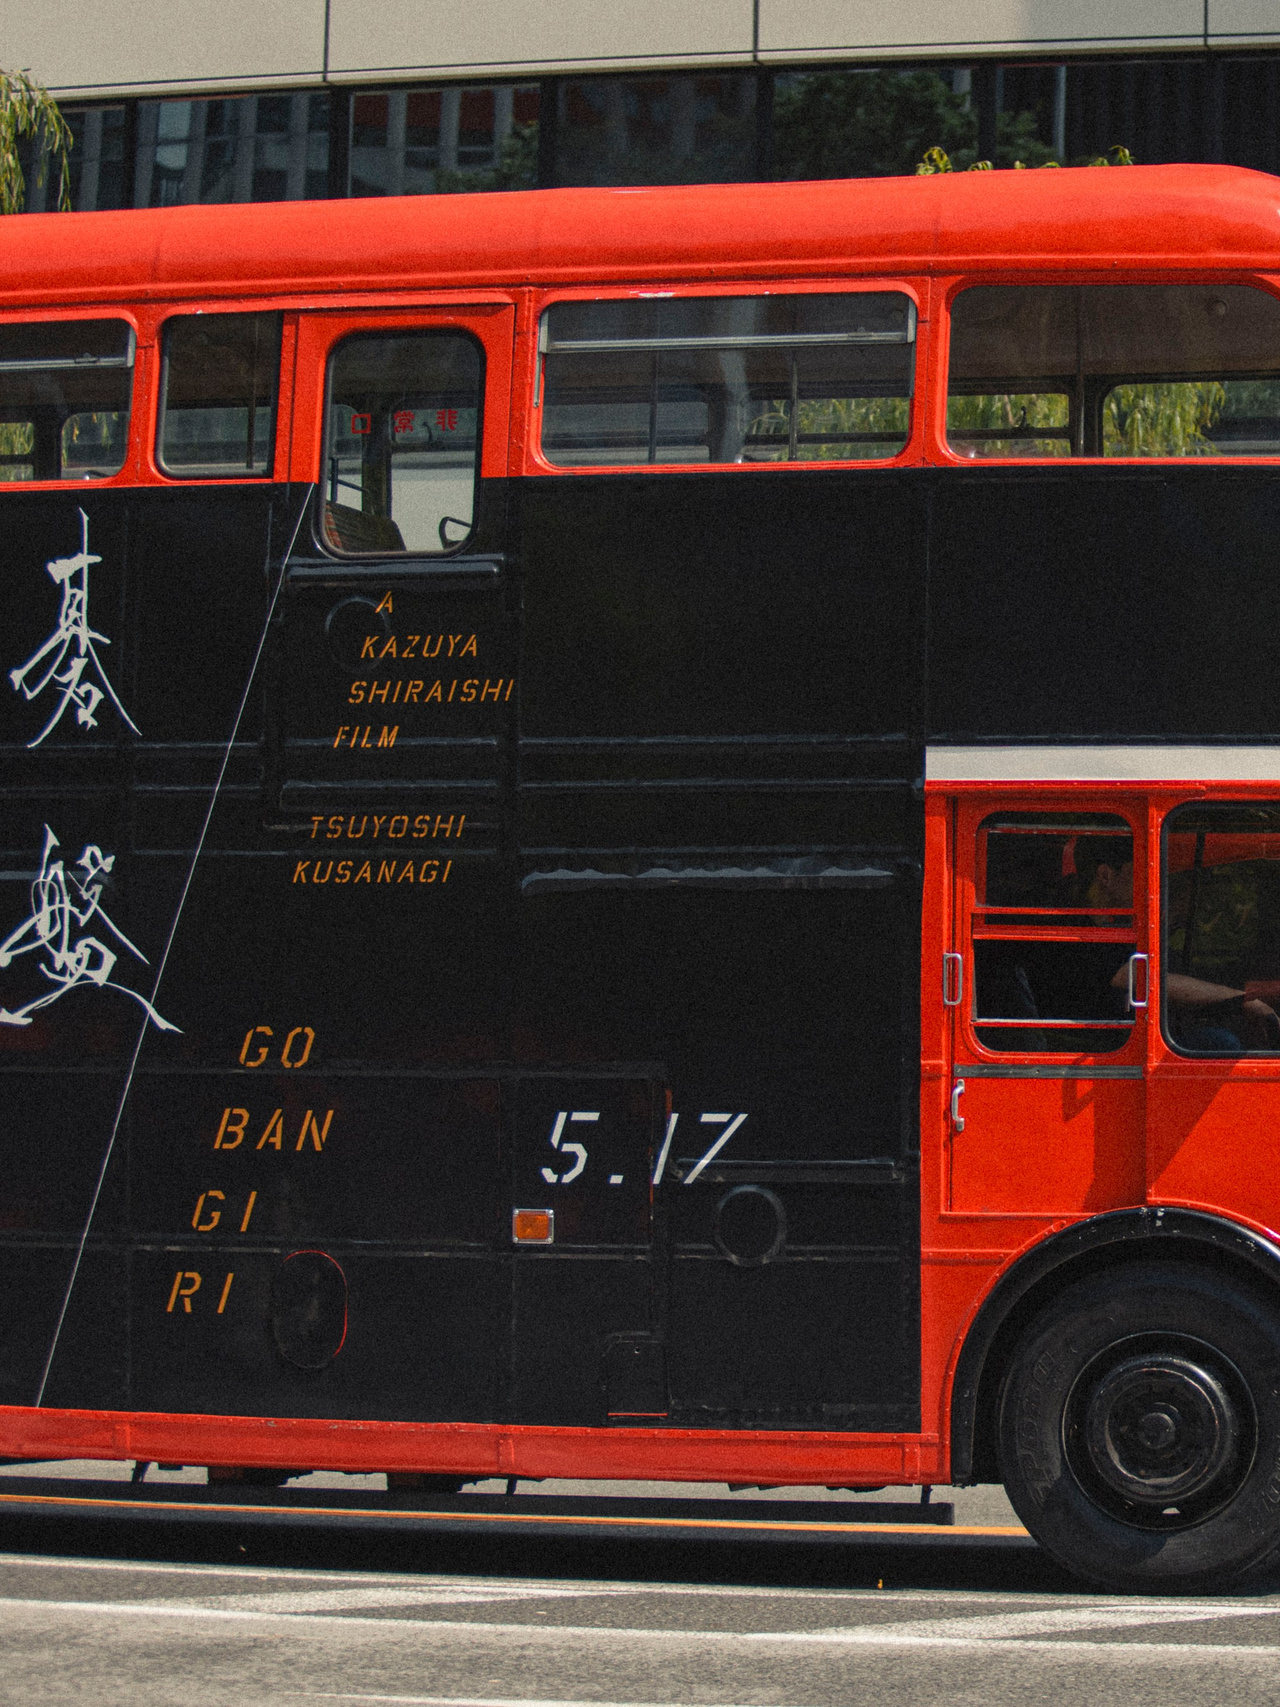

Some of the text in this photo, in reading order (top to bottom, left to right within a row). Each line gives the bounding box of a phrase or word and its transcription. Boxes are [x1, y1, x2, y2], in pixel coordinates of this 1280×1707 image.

[374, 590, 393, 614] A
[360, 633, 478, 659] KAZUYA
[347, 678, 515, 705] SHIRAISHI
[332, 724, 400, 749] FILM
[310, 814, 466, 839] TSUYOSHI
[292, 859, 452, 884] KUSANAGI
[238, 1025, 316, 1069] GO
[212, 1107, 335, 1152] BAN
[540, 1110, 749, 1186] 5.17
[190, 1189, 258, 1233] GI
[165, 1271, 235, 1315] RI
